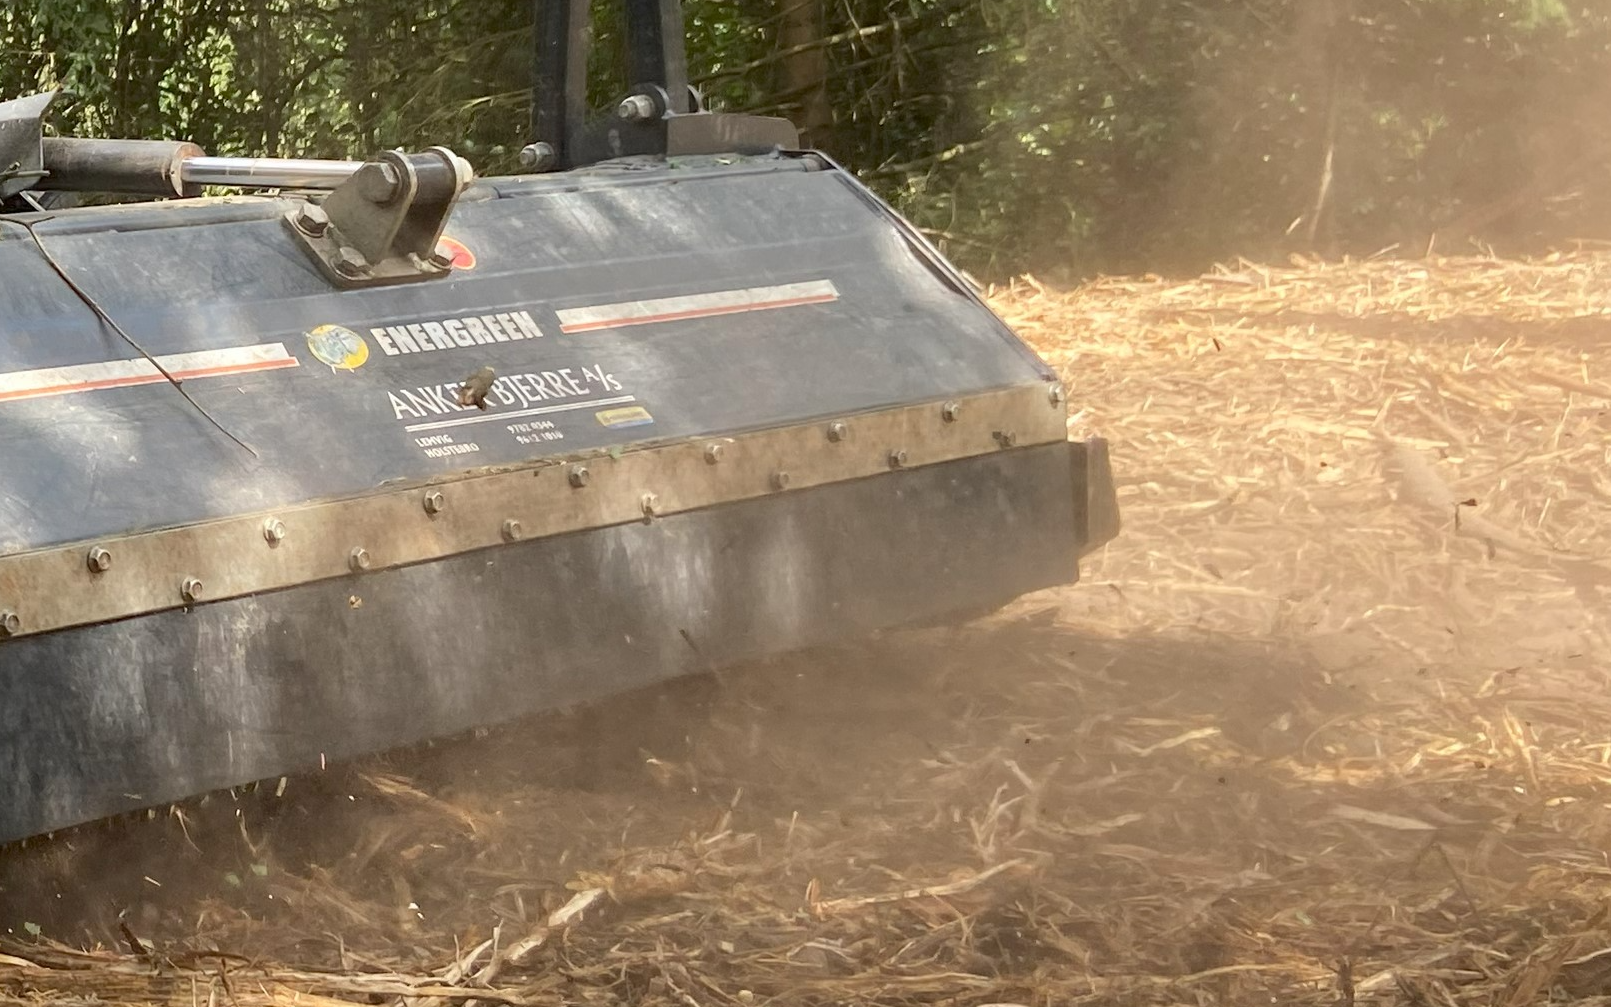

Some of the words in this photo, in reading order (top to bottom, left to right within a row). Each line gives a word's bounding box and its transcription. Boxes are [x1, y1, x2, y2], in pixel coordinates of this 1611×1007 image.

[370, 311, 543, 355] ENERGREEN
[388, 381, 497, 419] ANKE
[492, 369, 590, 408] BJERRE
[415, 434, 453, 447] LEMVIG
[424, 442, 480, 458] HOLSTEBRO
